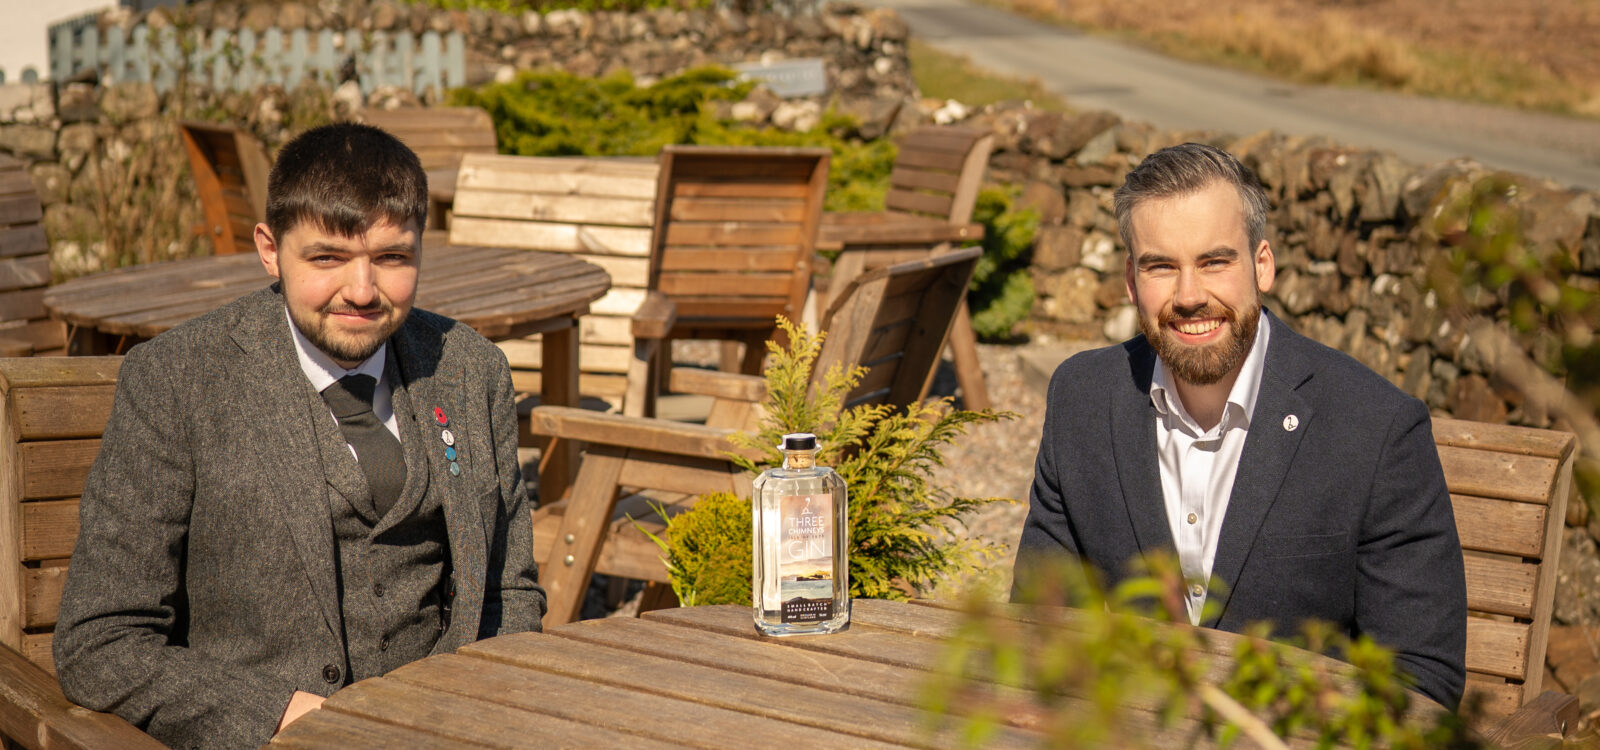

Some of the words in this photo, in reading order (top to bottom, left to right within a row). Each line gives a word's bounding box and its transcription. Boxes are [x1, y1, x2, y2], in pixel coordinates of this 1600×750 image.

[788, 516, 825, 527] THREE
[788, 527, 825, 535] CHIMNEYS
[788, 540, 825, 560] GIN
